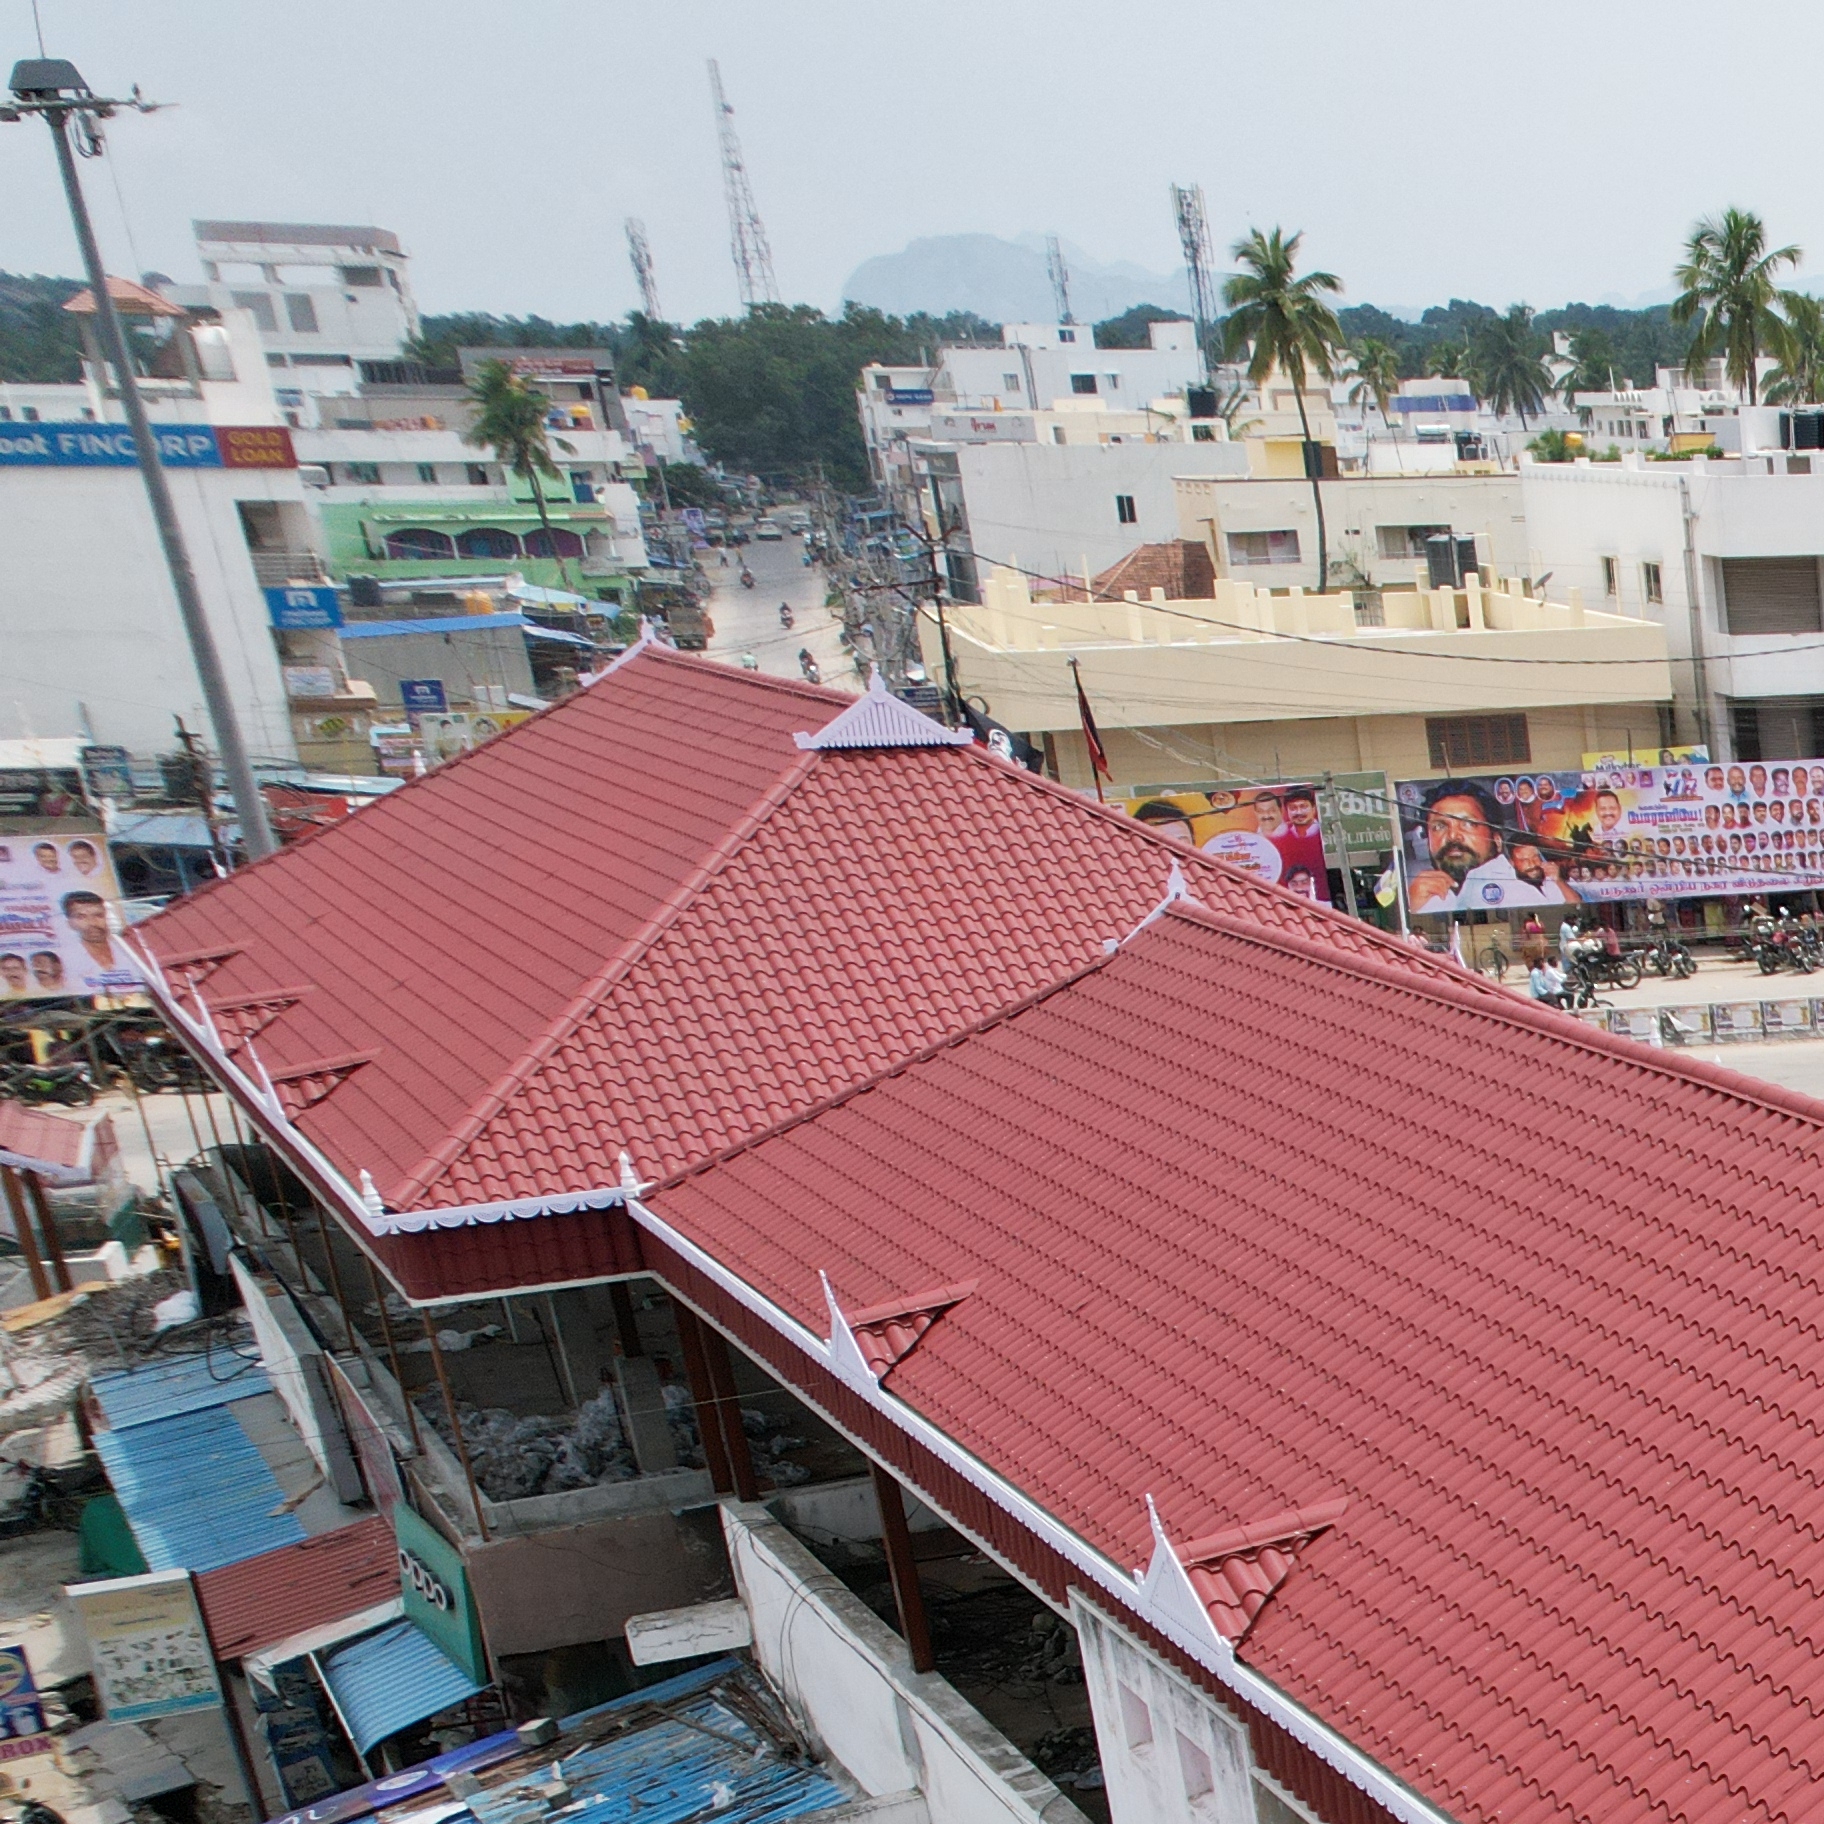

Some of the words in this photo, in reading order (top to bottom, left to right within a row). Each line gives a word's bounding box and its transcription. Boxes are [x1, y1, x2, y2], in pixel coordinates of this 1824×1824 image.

[57, 430, 211, 458] FINCRP
[227, 432, 281, 447] GOLD
[233, 449, 285, 463] LOAN
[401, 1548, 448, 1611] oppo
